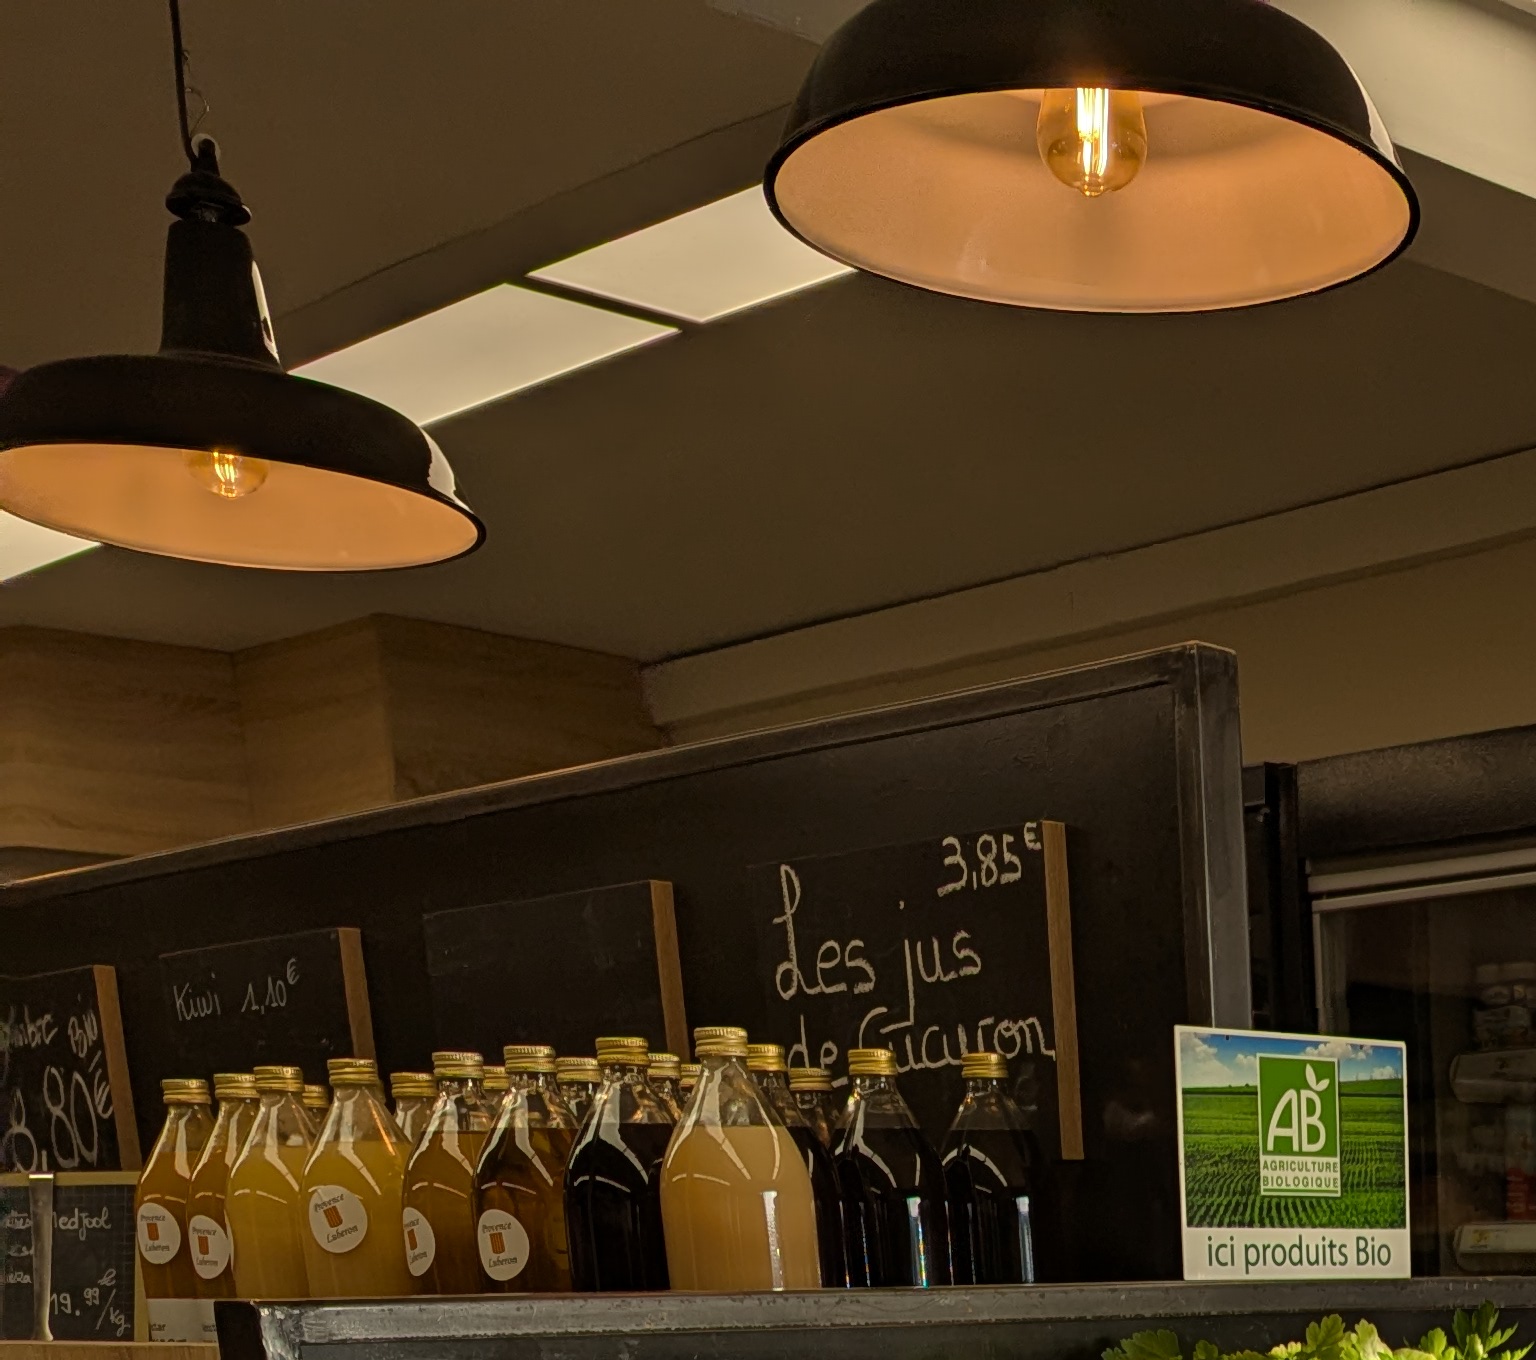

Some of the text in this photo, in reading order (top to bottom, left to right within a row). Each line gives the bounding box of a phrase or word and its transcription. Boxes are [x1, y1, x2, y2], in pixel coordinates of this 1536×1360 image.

[772, 863, 982, 1033] Les jus
[173, 972, 221, 1021] Kiwi
[1267, 1088, 1326, 1152] AB
[1262, 1160, 1339, 1173] AGRICULTURE
[1262, 1175, 1339, 1188] BIOLOGIQUE
[1207, 1234, 1392, 1275] ici produits Bio
